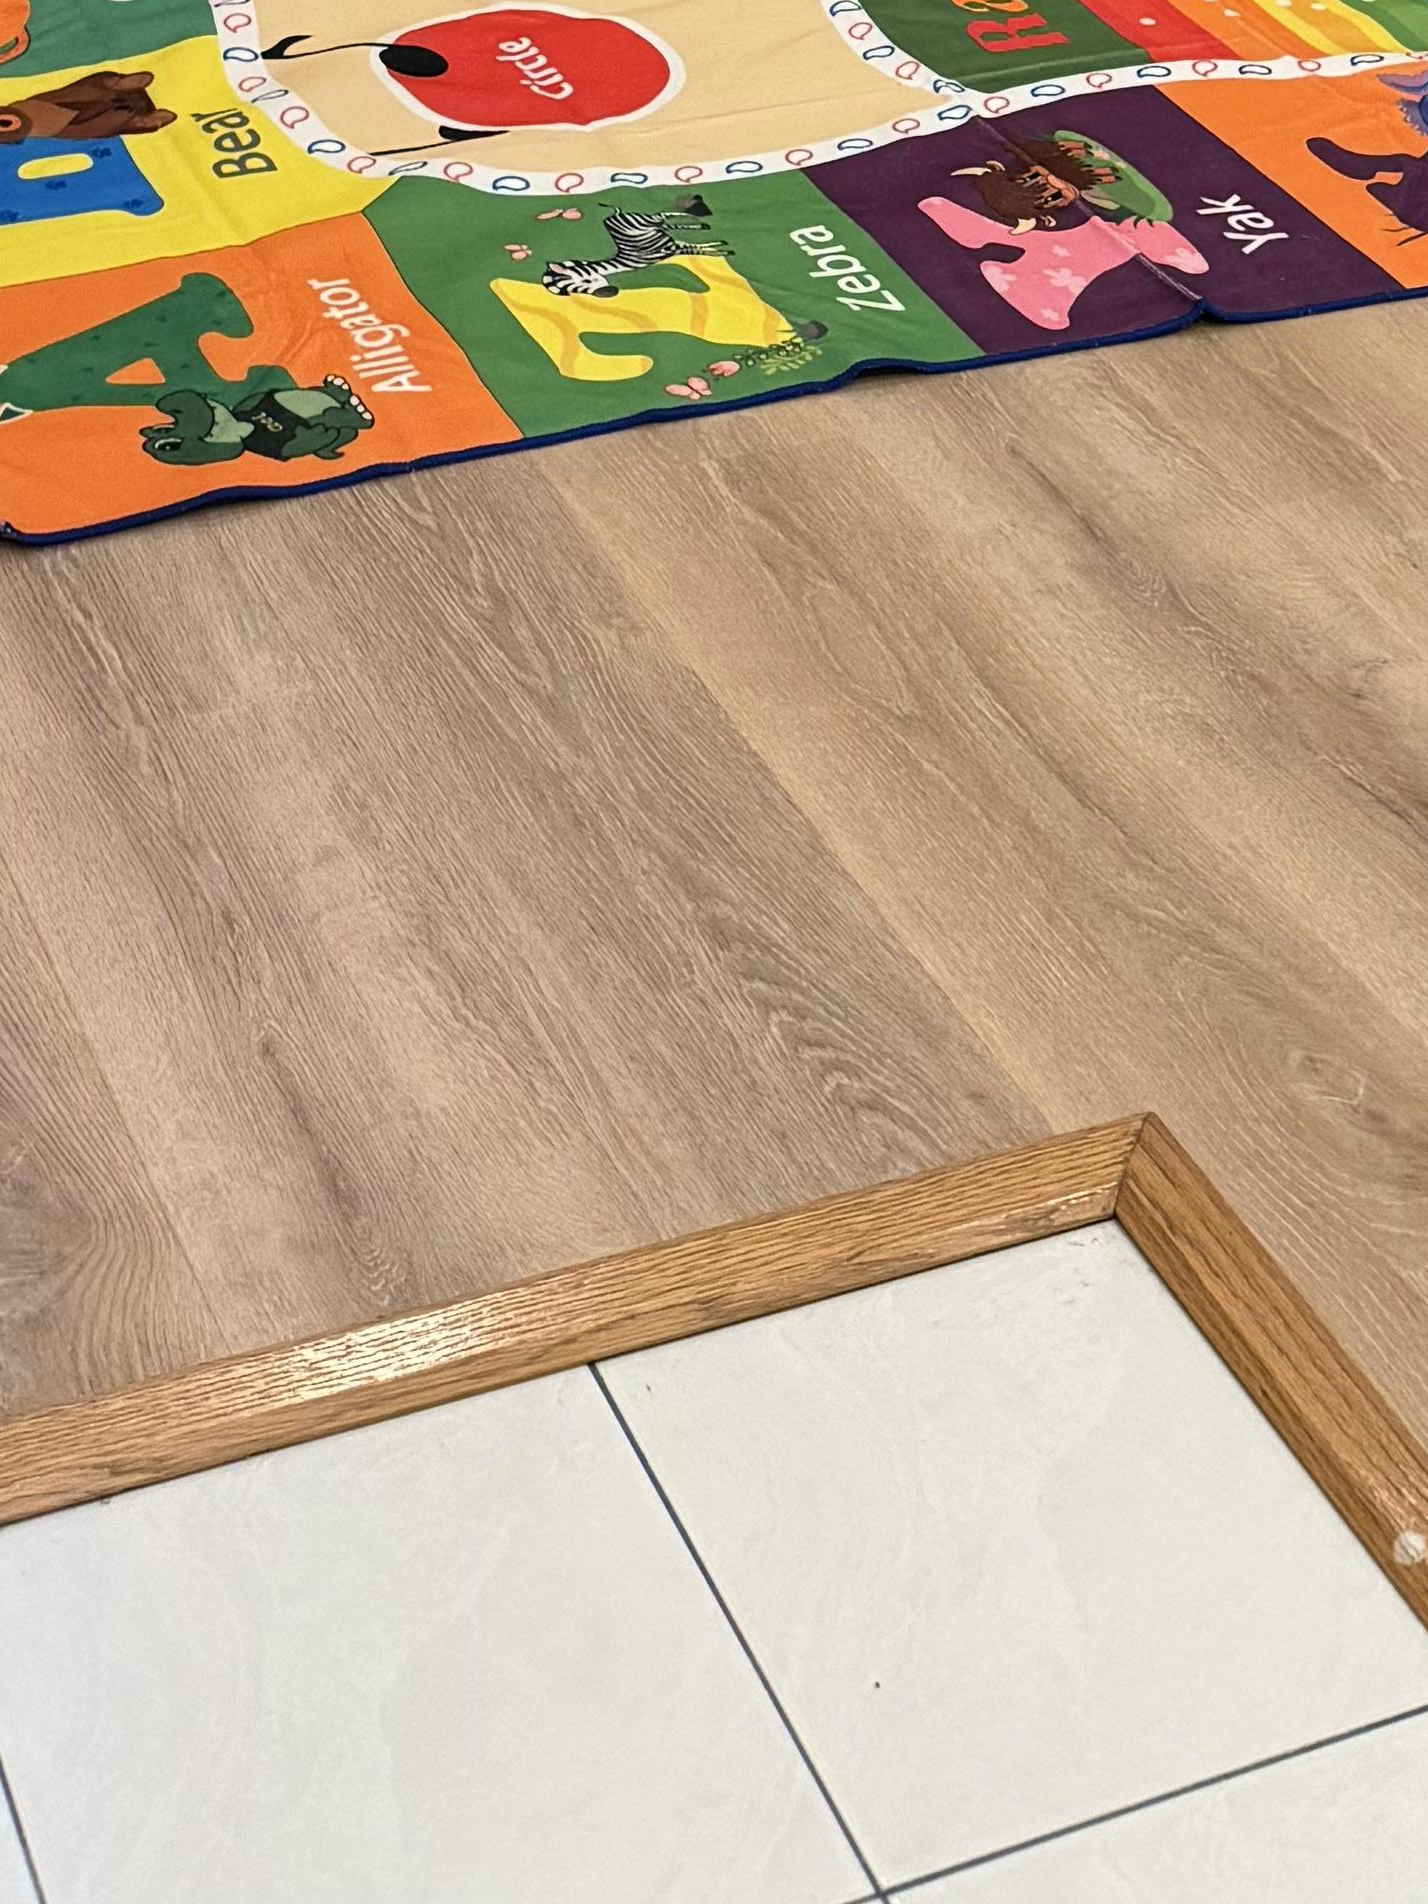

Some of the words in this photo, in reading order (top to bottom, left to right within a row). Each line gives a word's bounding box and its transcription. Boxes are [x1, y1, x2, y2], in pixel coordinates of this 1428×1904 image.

[496, 37, 572, 99] Circle
[210, 109, 277, 178] Bear
[917, 196, 1209, 329] Y
[1196, 193, 1288, 253] Yak
[789, 225, 905, 310] Zebra
[307, 278, 431, 392] Alligator
[490, 254, 794, 381] Z
